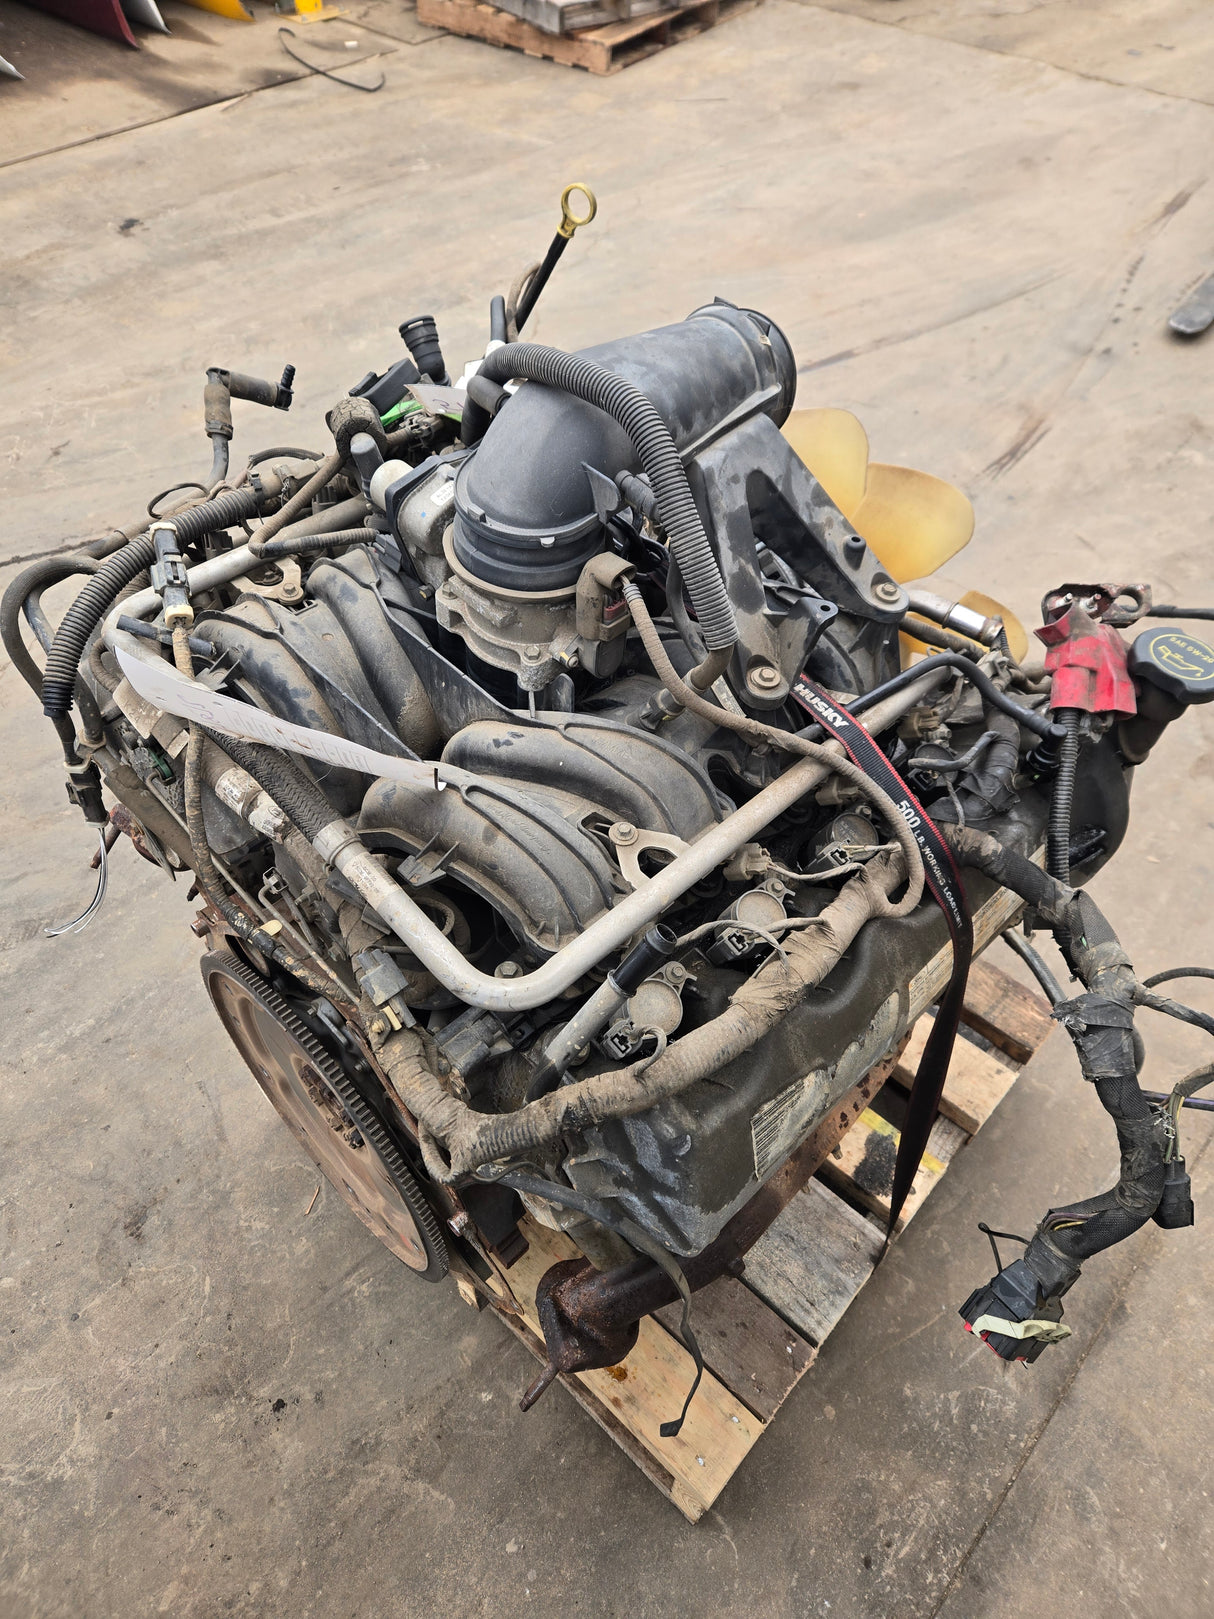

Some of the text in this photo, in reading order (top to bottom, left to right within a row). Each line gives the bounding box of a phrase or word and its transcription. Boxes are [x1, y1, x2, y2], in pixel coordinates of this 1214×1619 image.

[793, 683, 850, 728] HUSKY
[896, 800, 922, 829] 500
[922, 845, 946, 886] WORKING
[943, 886, 956, 910] LOAD
[952, 907, 963, 928] LIMIT
